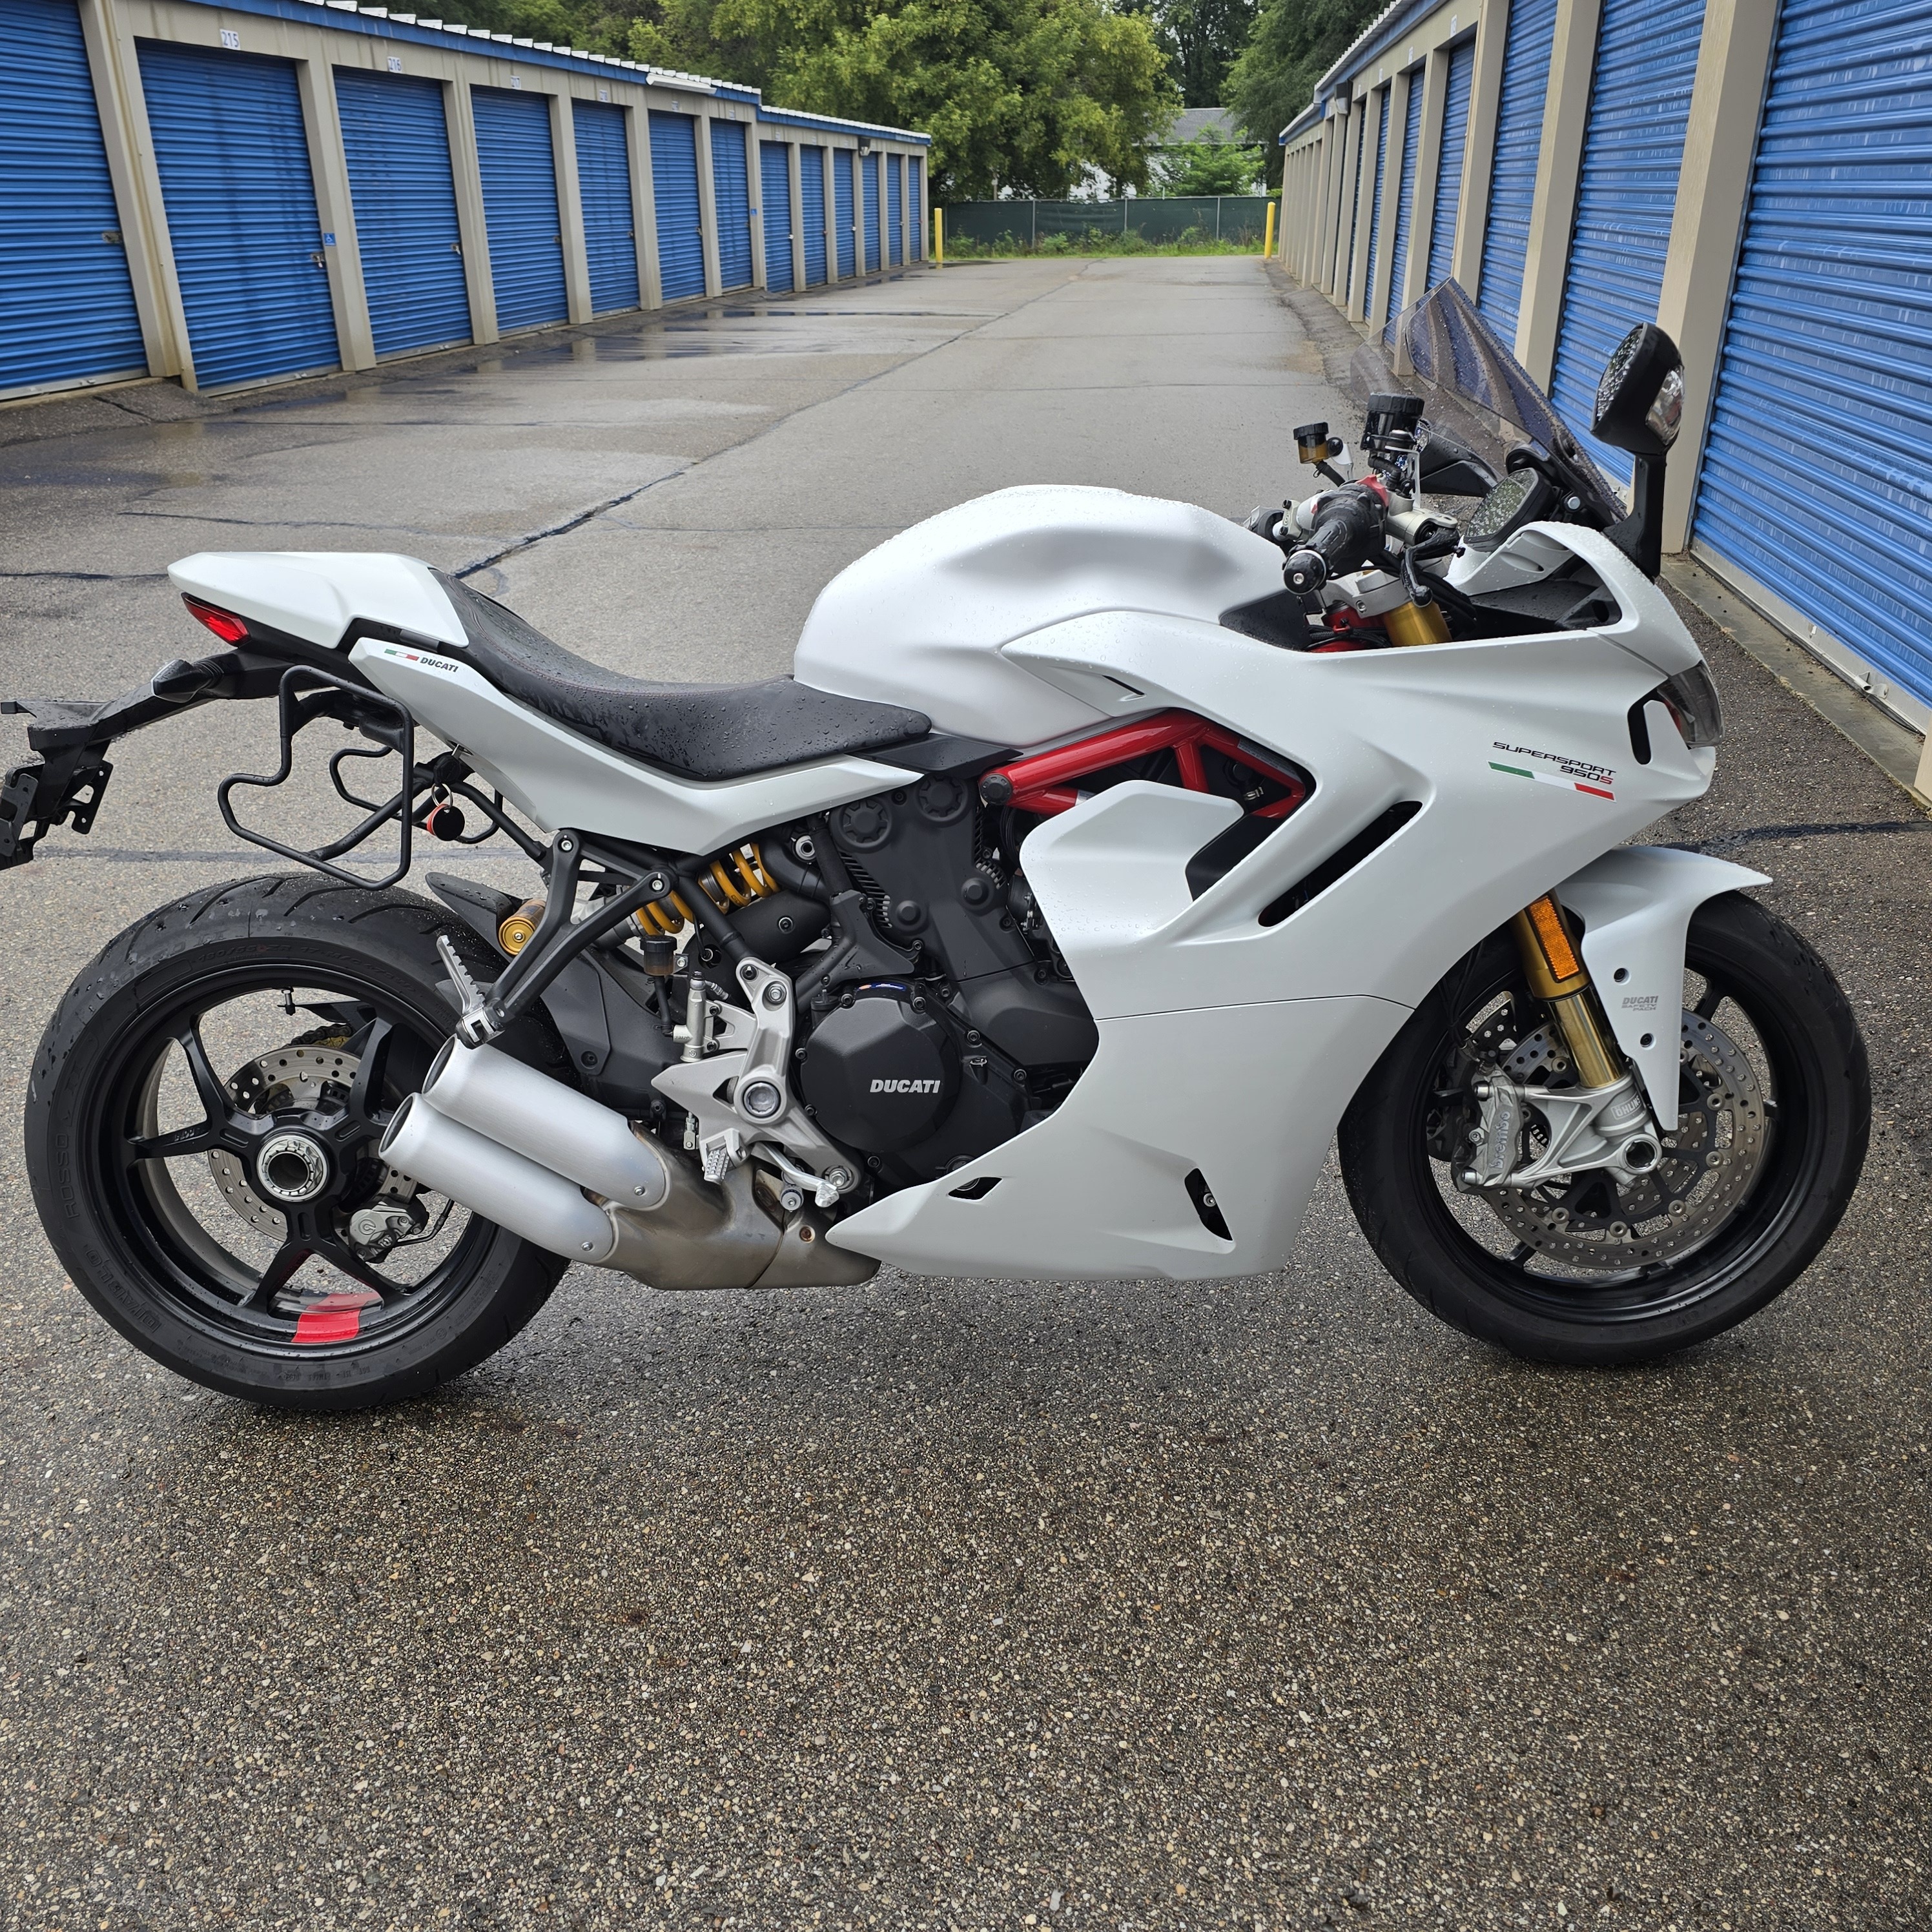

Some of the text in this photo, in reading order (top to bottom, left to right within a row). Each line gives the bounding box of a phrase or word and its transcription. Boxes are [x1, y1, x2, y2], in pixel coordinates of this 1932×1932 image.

[221, 31, 239, 48] 215
[389, 58, 402, 71] 216
[420, 657, 459, 673] DUCATI
[1492, 741, 1616, 776] SUPERSPORT
[1559, 765, 1614, 785] 950S
[1622, 995, 1658, 1005] DUCATI
[869, 1079, 941, 1093] DUCATI
[1488, 1111, 1511, 1169] brembo
[55, 1133, 79, 1219] ROSSO
